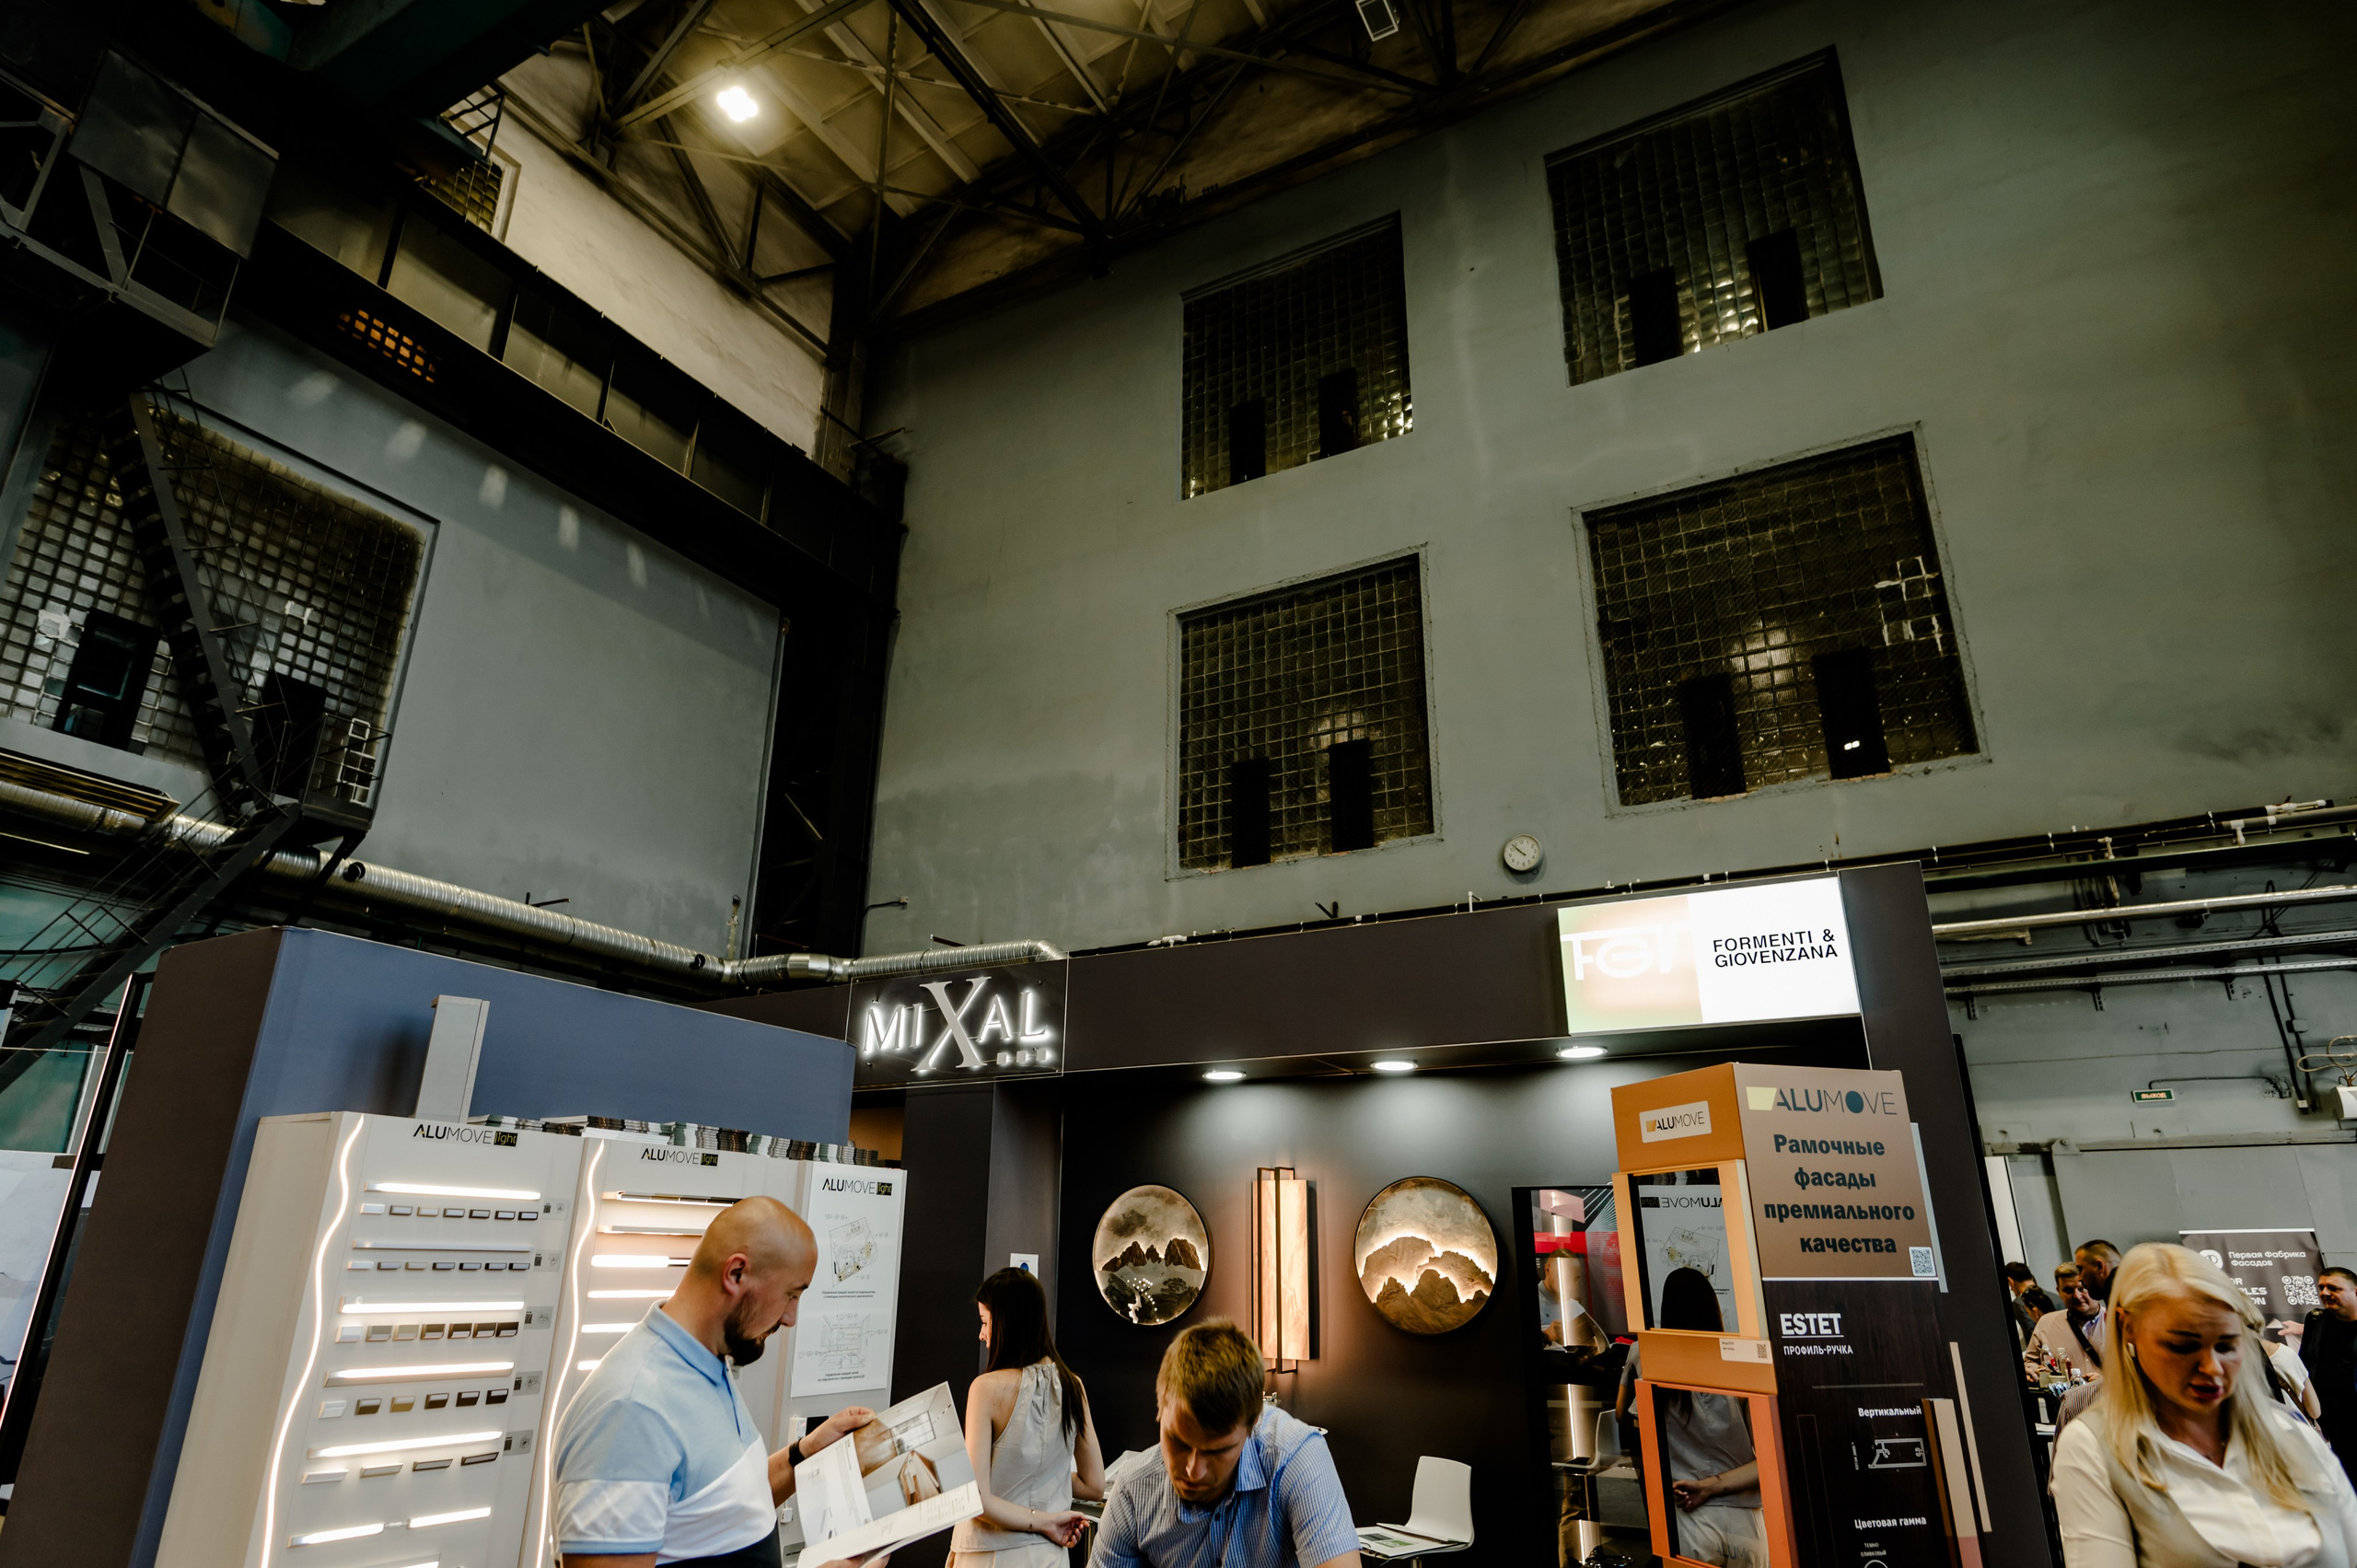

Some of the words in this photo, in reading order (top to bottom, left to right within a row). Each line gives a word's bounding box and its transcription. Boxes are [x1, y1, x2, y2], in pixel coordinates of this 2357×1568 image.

[1713, 930, 1813, 952] FORMENTI
[1822, 928, 1836, 942] &
[1714, 944, 1839, 968] GIOVENZANA
[1777, 1088, 1898, 1115] ALUMOVE
[1655, 1111, 1705, 1131] ALUMOVE
[412, 1123, 493, 1144] ALUMOVE
[1773, 1133, 1886, 1156] Рамочные
[641, 1148, 701, 1165] ALUMOVE
[822, 1178, 876, 1194] ALUMOVE
[1794, 1167, 1876, 1190] фасады
[1764, 1203, 1915, 1223] премиального
[1800, 1237, 1897, 1253] качества
[2228, 1251, 2262, 1260] Первая
[2264, 1250, 2306, 1260] Фабрика
[1780, 1313, 1841, 1335] ESTET
[1783, 1345, 1853, 1356] ПРОФИЛЬ-РУЧКА
[1858, 1405, 1922, 1418] Вертикальный
[1854, 1518, 1898, 1530] Цветовая
[1898, 1516, 1927, 1527] гамма
